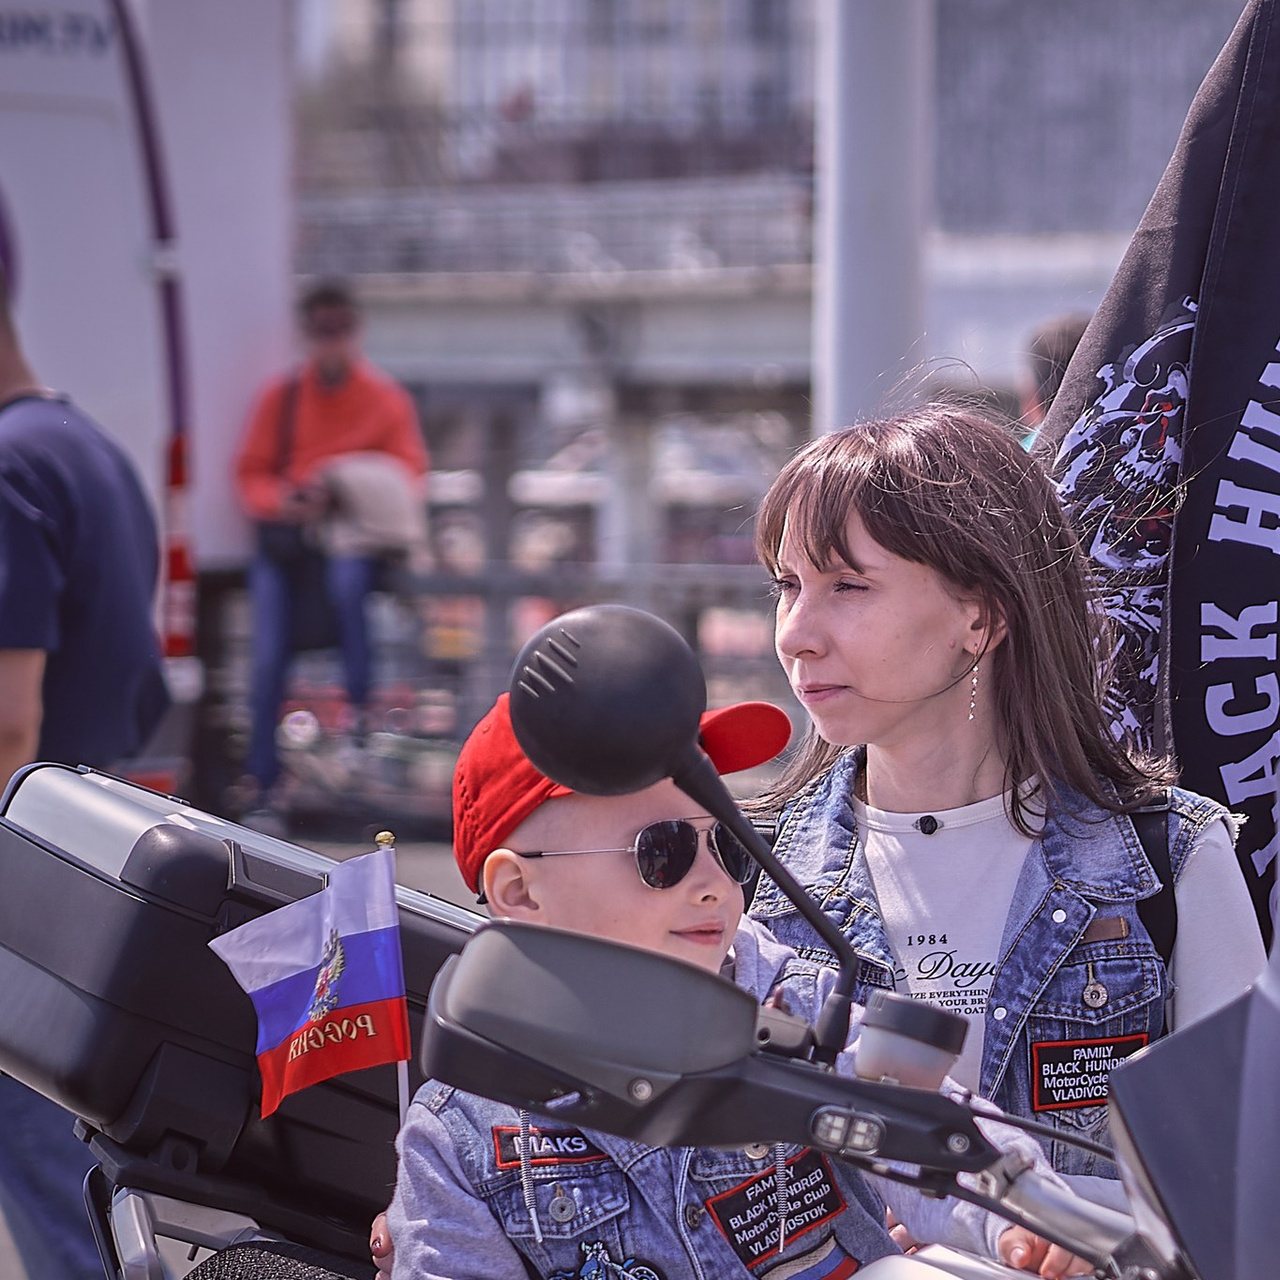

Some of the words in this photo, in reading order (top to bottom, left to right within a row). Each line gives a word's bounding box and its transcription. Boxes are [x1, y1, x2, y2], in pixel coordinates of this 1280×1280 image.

[907, 933, 948, 946] 1984
[929, 988, 989, 1000] EVERYTHIN
[938, 998, 968, 1007] YOUR
[1073, 1045, 1114, 1061] FAMILY
[1042, 1061, 1082, 1076] BLACK
[1085, 1057, 1127, 1073] HUNDR
[1044, 1072, 1109, 1090] MotorCycle
[1052, 1084, 1109, 1102] VLADIVOS
[512, 1135, 588, 1155] MAKS
[745, 1165, 795, 1202] FAMY
[728, 1202, 768, 1230] BLACK
[769, 1168, 824, 1207] HNDRED
[734, 1201, 802, 1245] MotorCle
[803, 1182, 831, 1205] Club
[748, 1202, 828, 1256] VLADOSTOK
